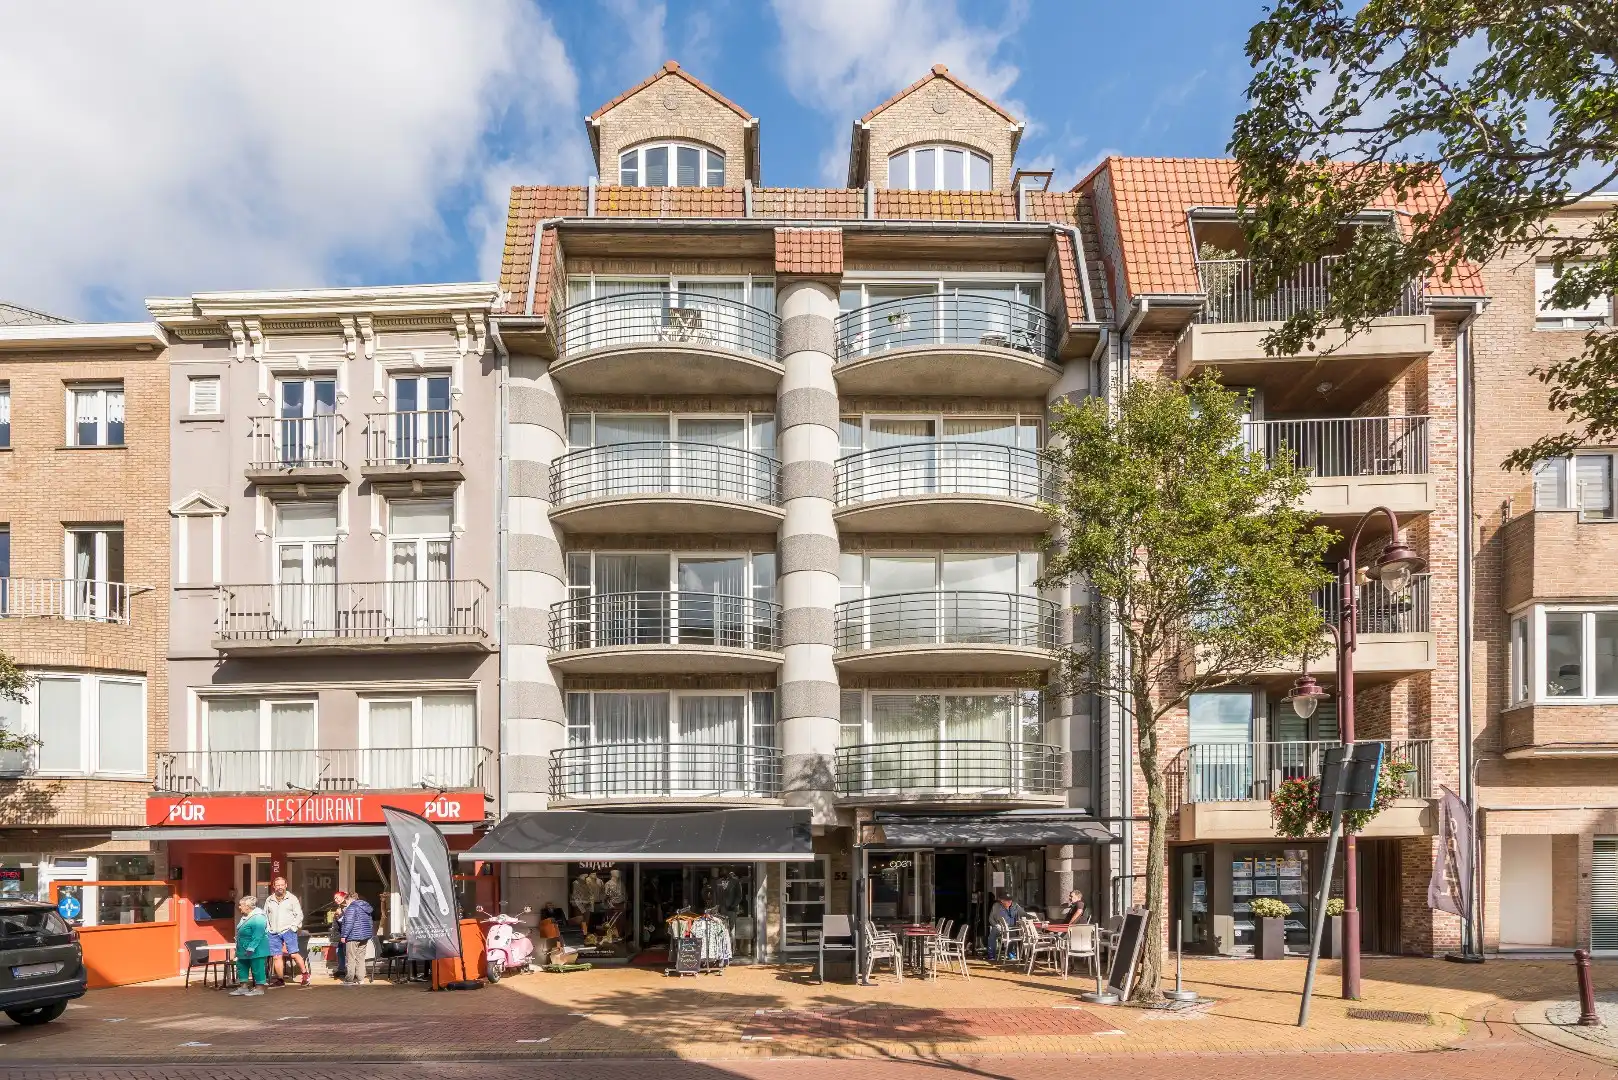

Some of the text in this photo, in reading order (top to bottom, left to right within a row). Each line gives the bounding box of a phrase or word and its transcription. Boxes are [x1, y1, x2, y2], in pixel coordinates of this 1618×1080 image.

[266, 798, 364, 822] RESTAURANT
[889, 860, 912, 869] open
[834, 871, 848, 880] 52
